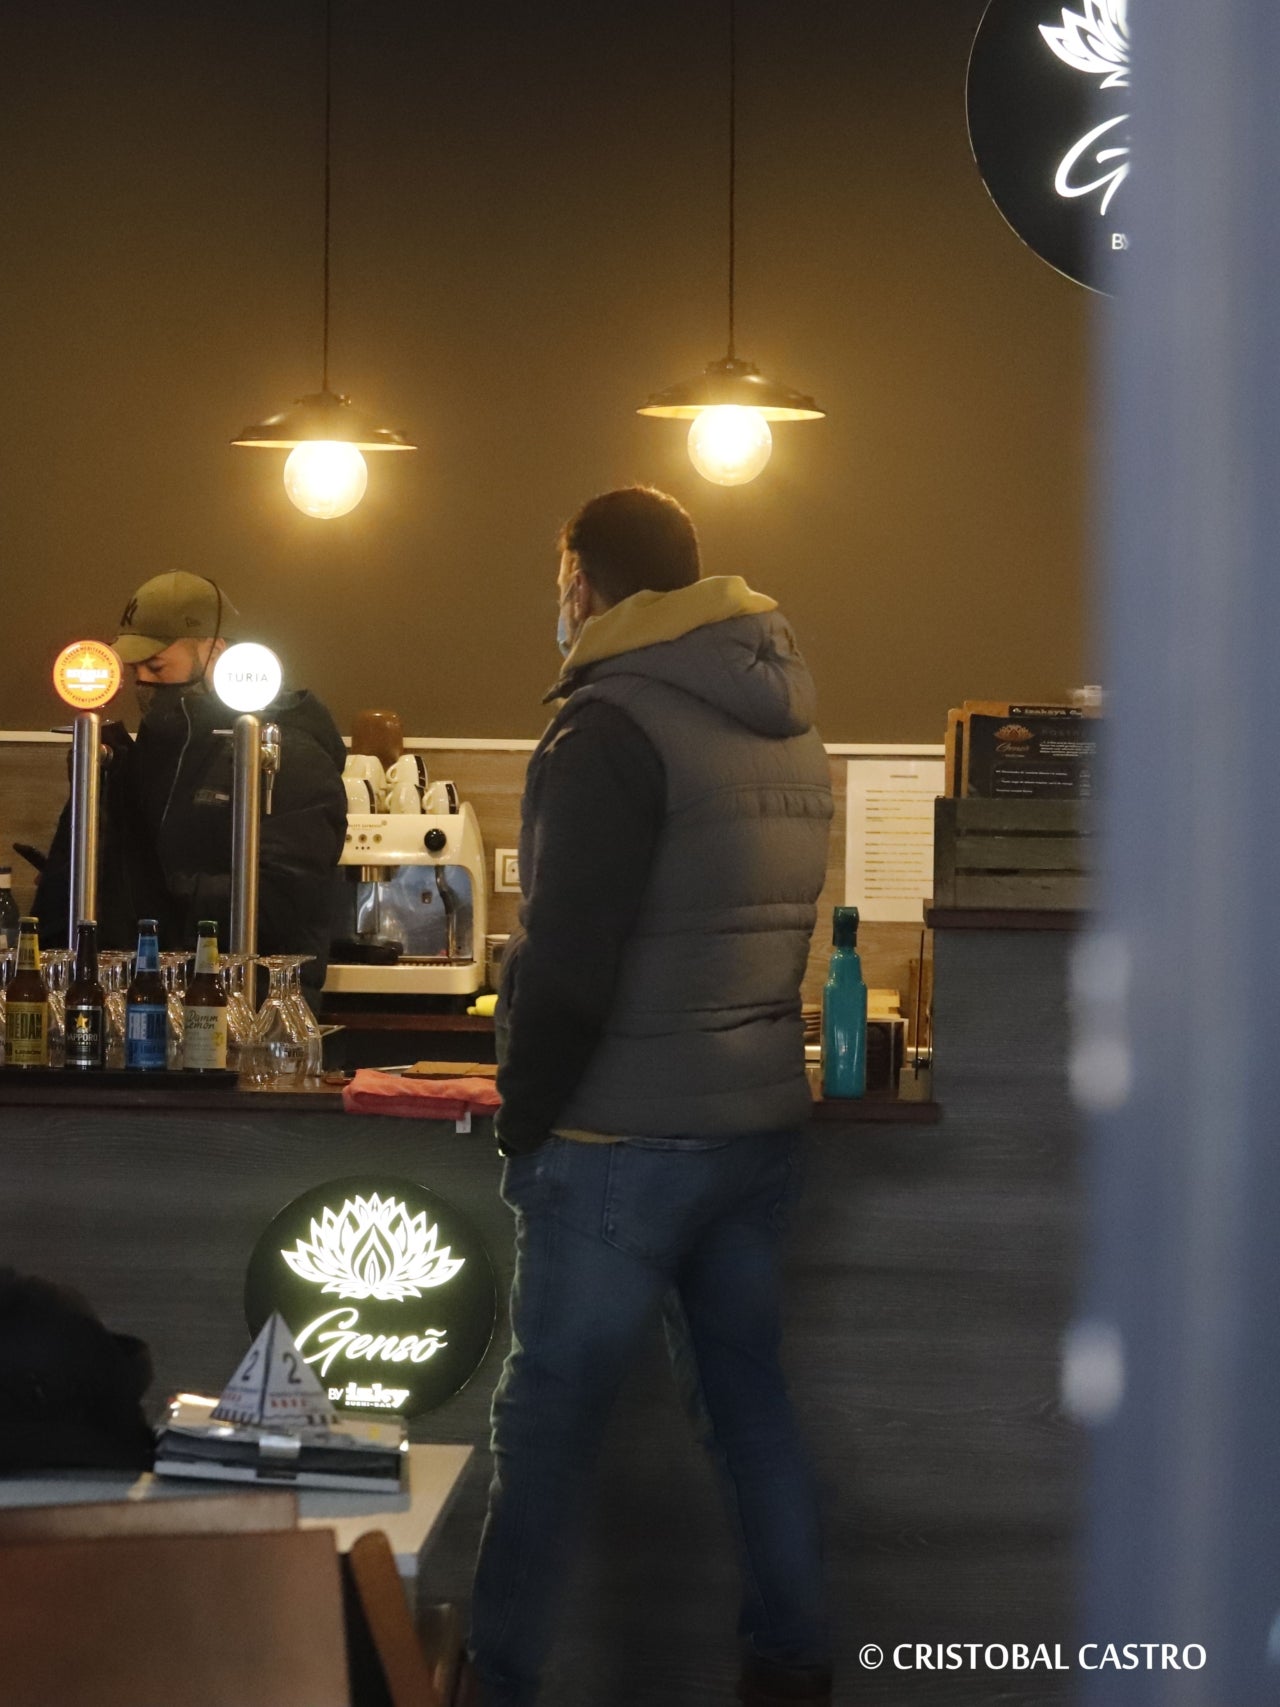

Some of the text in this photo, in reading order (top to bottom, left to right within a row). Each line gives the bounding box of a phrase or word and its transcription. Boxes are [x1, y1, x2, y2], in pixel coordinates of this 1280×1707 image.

[227, 672, 269, 683] TURIA
[241, 1349, 259, 1382] 2
[282, 1351, 302, 1384] 2
[328, 1387, 344, 1401] BY
